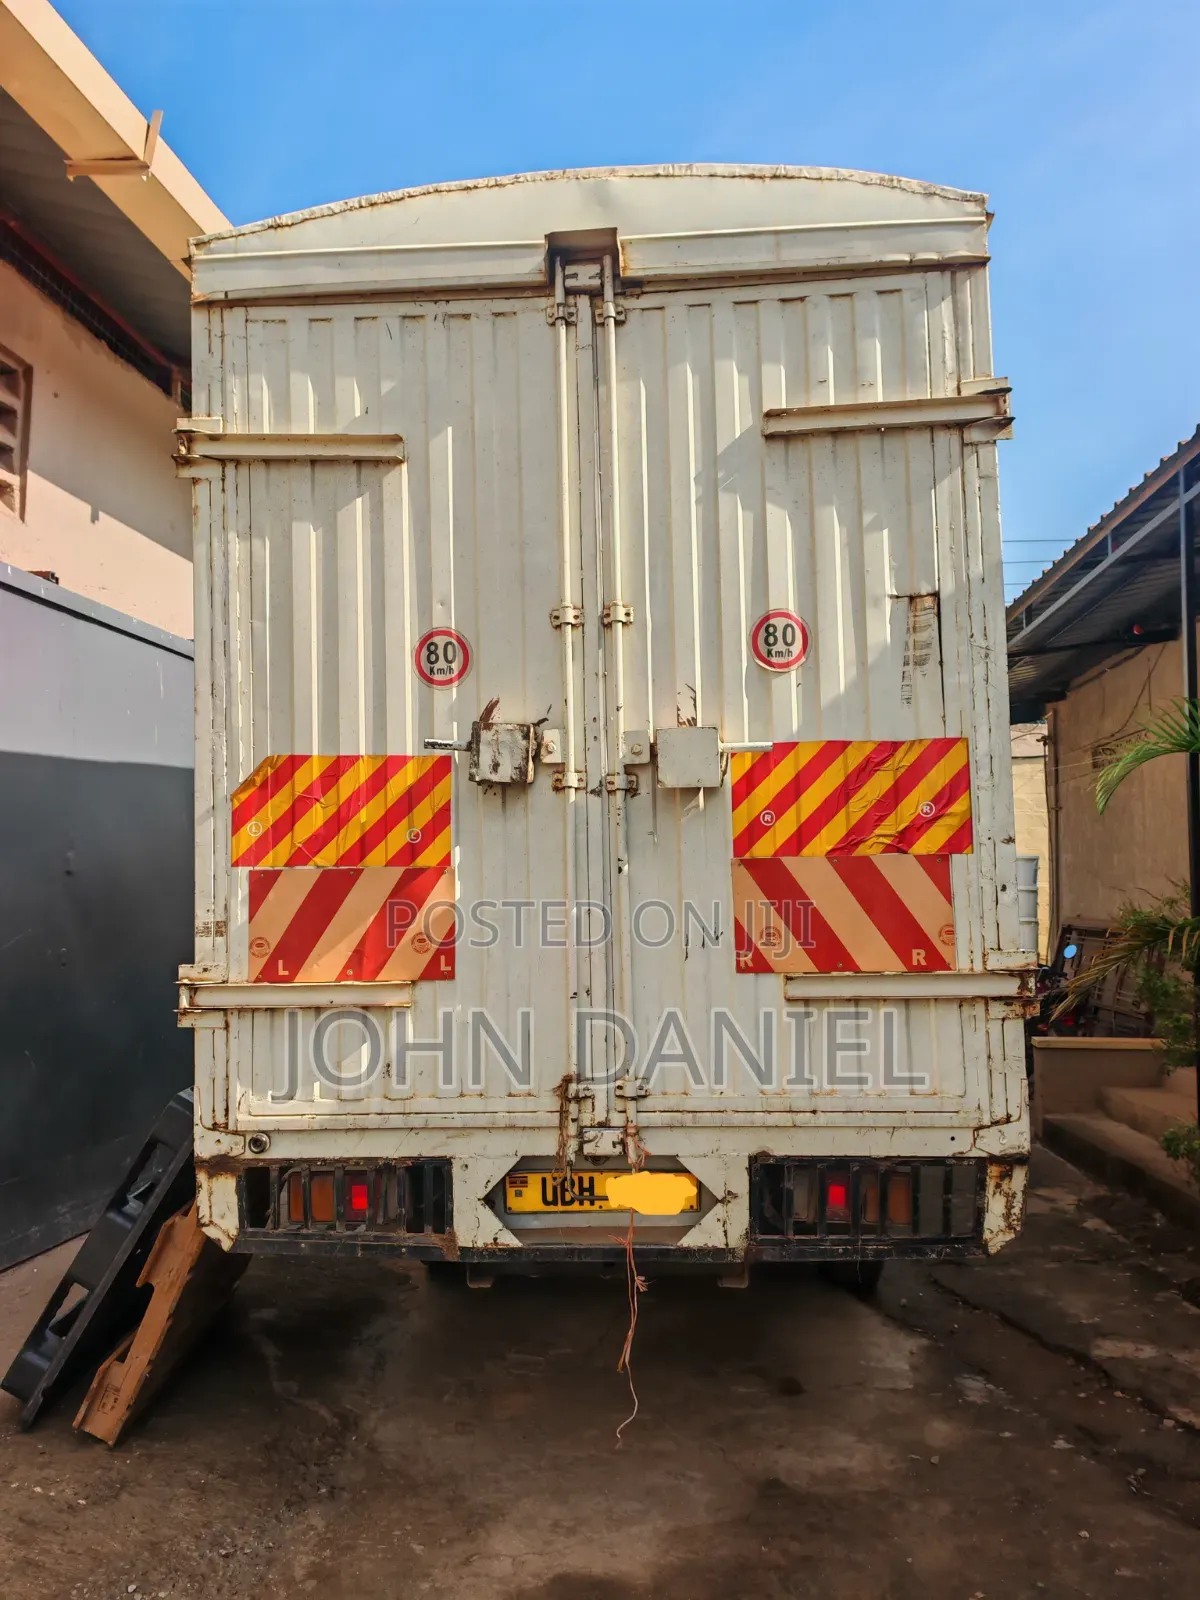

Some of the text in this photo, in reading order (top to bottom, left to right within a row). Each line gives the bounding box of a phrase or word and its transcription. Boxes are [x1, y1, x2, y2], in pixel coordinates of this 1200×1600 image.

[764, 623, 796, 647] 80
[426, 641, 457, 665] 80
[766, 648, 793, 658] Km/h
[429, 665, 455, 676] Km/h
[440, 955, 451, 971] L
[912, 949, 927, 966] R
[278, 959, 289, 976] L
[541, 1176, 595, 1207] UBH
